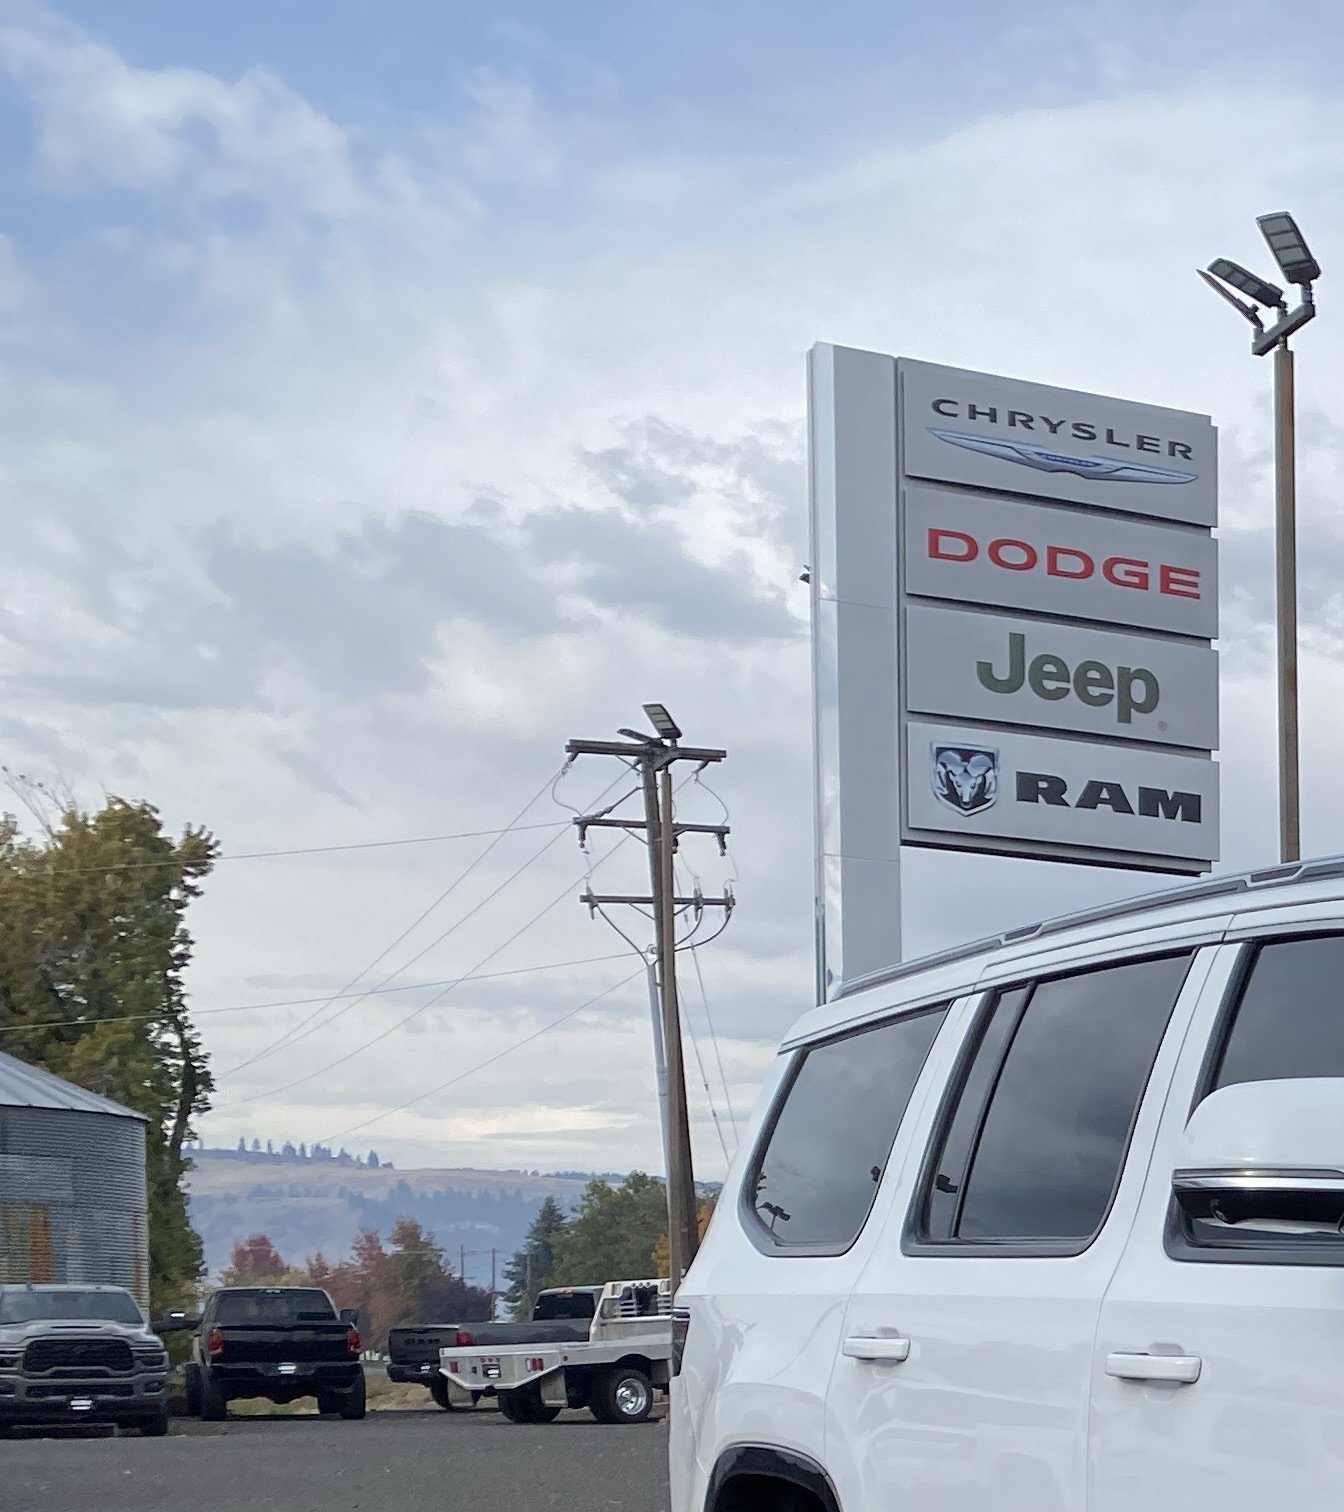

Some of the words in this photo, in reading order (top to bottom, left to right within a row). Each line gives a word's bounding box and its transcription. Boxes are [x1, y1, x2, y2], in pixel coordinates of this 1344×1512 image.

[931, 399, 1193, 460] CHRYSLER
[928, 527, 1200, 599] DODGE
[976, 632, 1160, 724] Jeep
[1016, 771, 1202, 824] RAM
